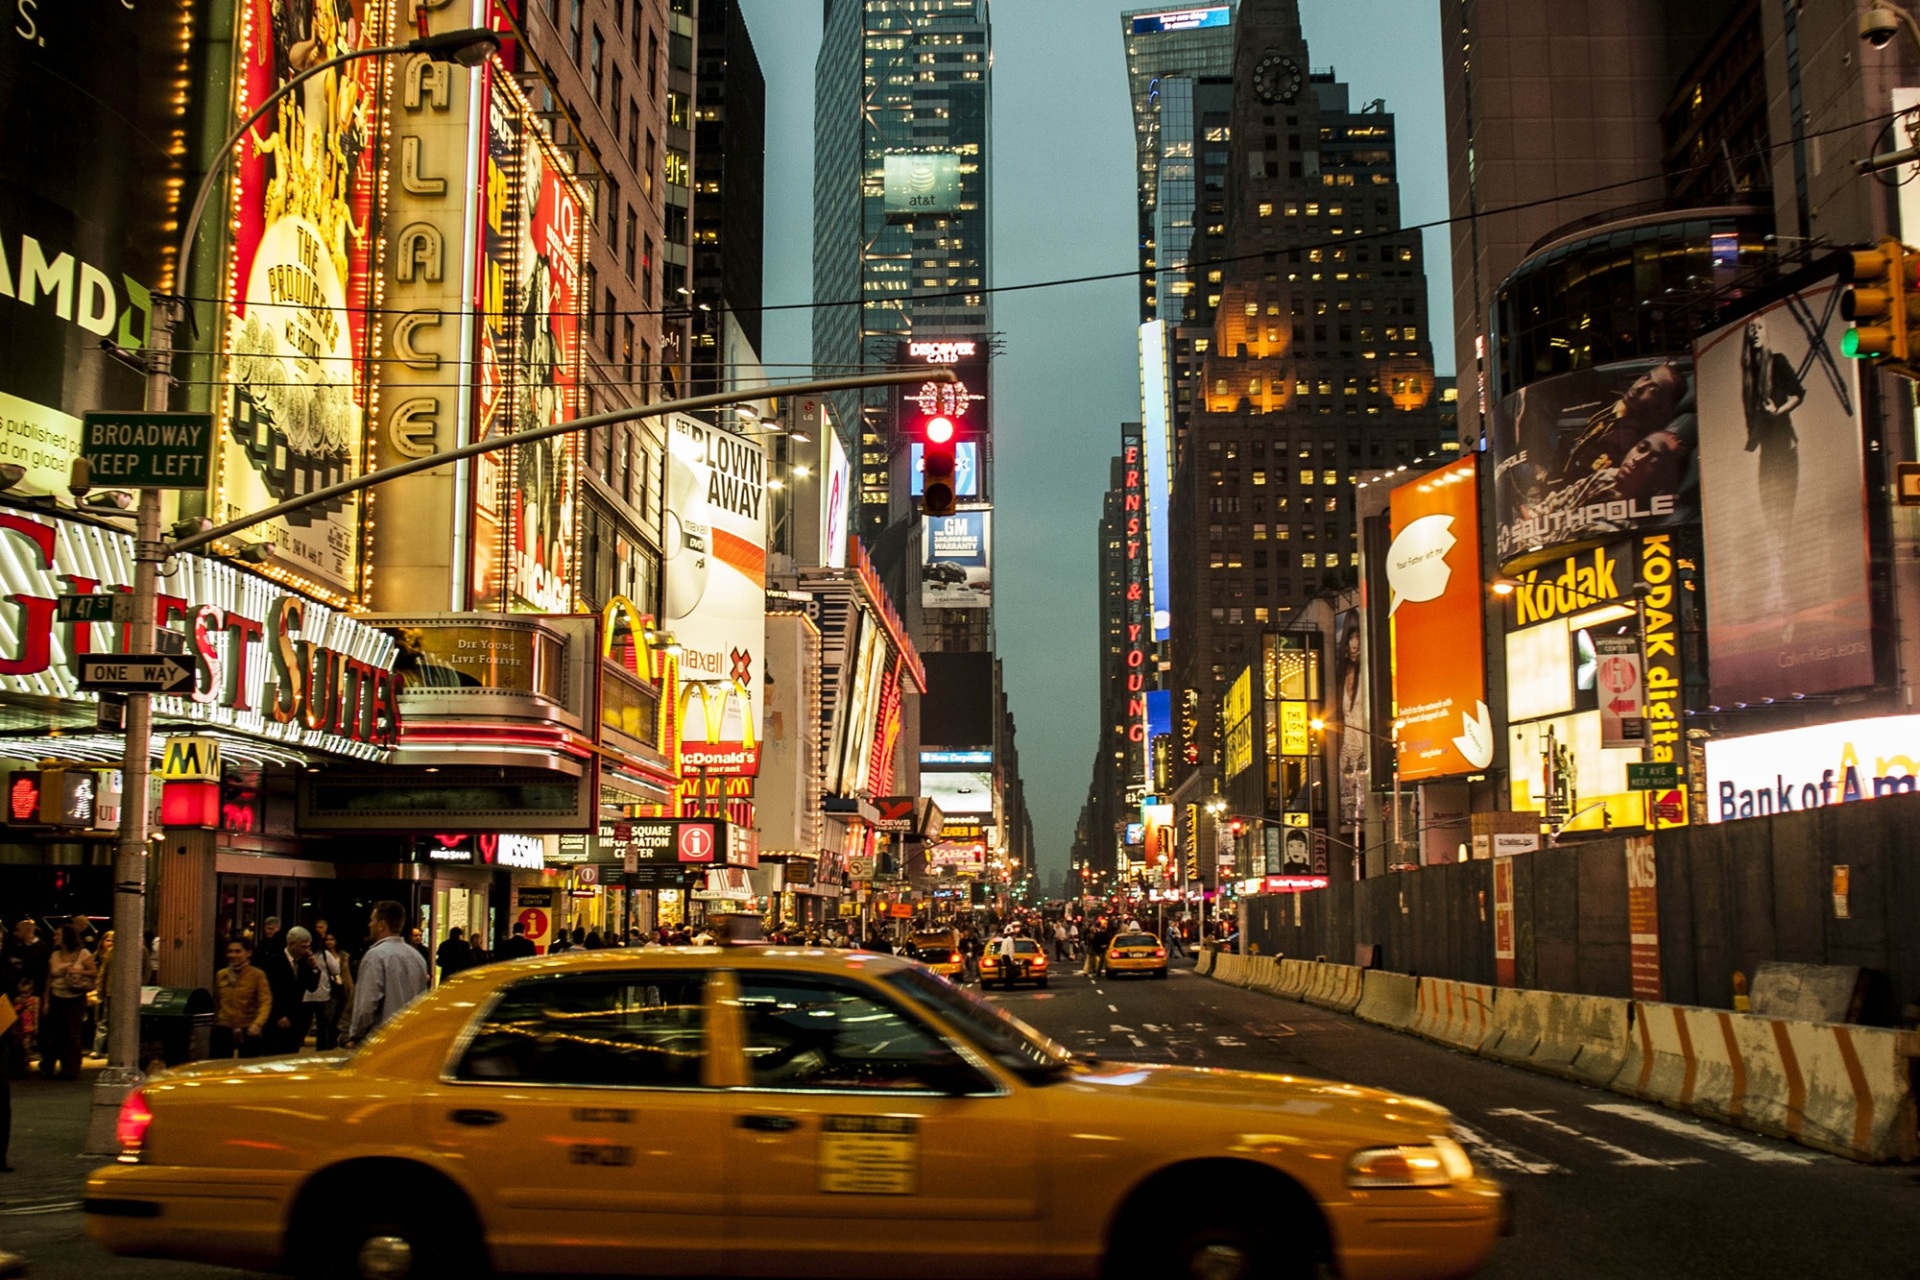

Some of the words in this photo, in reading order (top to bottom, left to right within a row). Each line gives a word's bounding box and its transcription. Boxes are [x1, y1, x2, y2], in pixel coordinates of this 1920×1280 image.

[909, 194, 936, 206] at&t
[553, 178, 574, 247] 10
[297, 225, 320, 277] THE
[268, 263, 340, 354] PRODUCERS
[910, 342, 976, 356] DISCOVER
[926, 354, 958, 363] CARD
[7, 419, 67, 450] published
[91, 424, 202, 446] BROADWAY
[676, 419, 690, 435] GET
[12, 446, 28, 461] on
[32, 450, 67, 474] global
[87, 454, 140, 475] KEEP
[152, 455, 204, 477] LEFT
[707, 469, 762, 521] AWAY
[1125, 445, 1141, 554] ERNST
[944, 518, 968, 535] GM
[1512, 493, 1674, 544] SOUTHPOLE
[1126, 583, 1142, 600] &
[1516, 547, 1620, 626] Kodak
[1643, 534, 1675, 658] KODAK
[60, 598, 71, 618] W
[76, 598, 93, 619] 47
[97, 597, 110, 608] ST
[94, 666, 128, 681] ONE
[143, 666, 179, 681] WAY
[1127, 624, 1144, 741] YOUNG
[1287, 711, 1301, 720] THE
[1642, 665, 1684, 776] digita
[1285, 721, 1305, 733] LION
[1284, 736, 1305, 747] KING
[1719, 773, 1795, 821] Bank
[1801, 768, 1834, 809] of
[631, 826, 671, 836] SQUARE
[614, 848, 654, 858] CEER
